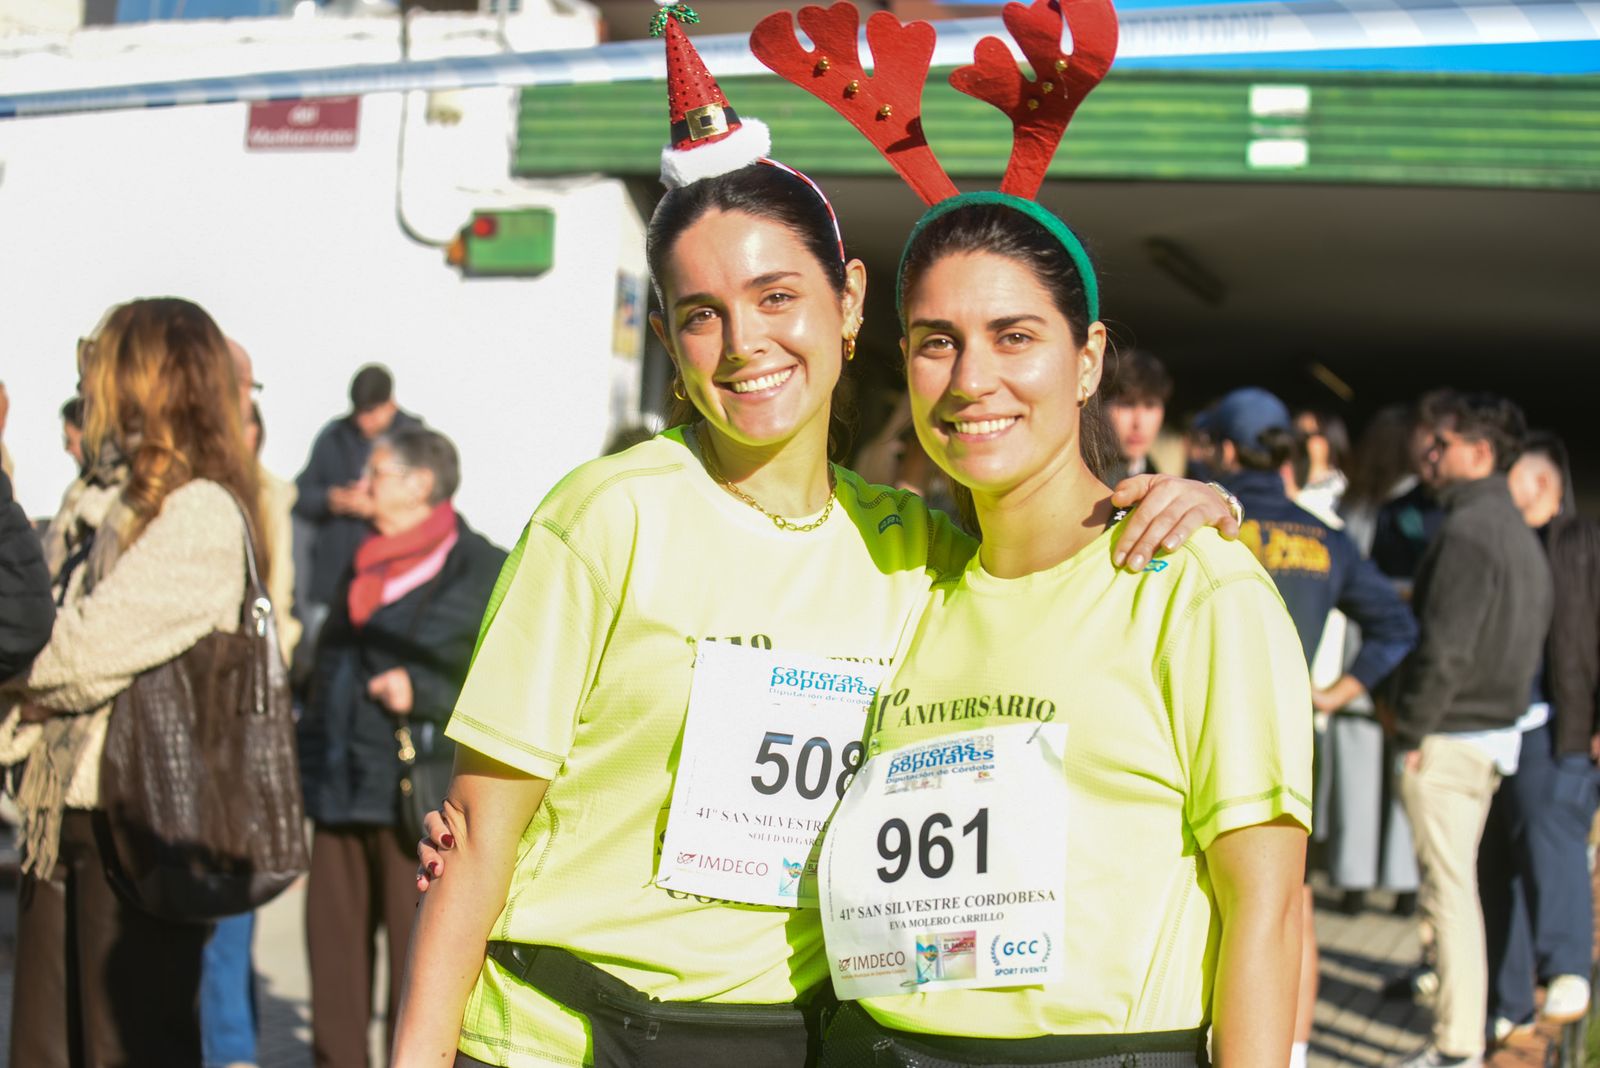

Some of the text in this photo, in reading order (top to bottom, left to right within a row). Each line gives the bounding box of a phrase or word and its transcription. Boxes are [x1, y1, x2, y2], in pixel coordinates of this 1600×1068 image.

[770, 675, 877, 696] populares
[772, 666, 863, 687] carreras
[898, 693, 1057, 730] ANIVERSARIO
[887, 749, 994, 777] populares
[890, 743, 975, 768] carreras
[886, 770, 934, 785] Diputación
[937, 769, 950, 777] de
[720, 810, 750, 824] SAN
[877, 807, 989, 883] 961
[698, 854, 769, 877] IMDECO
[858, 904, 882, 919] SAN
[884, 895, 961, 916] SILVESTRE
[964, 889, 1056, 908] CORDOBESA
[889, 911, 1005, 931] EVA MOLERO CARRILLO
[1003, 940, 1039, 956] GCC
[852, 951, 906, 971] IMDECO
[994, 965, 1047, 977] SPORT EVENTS
